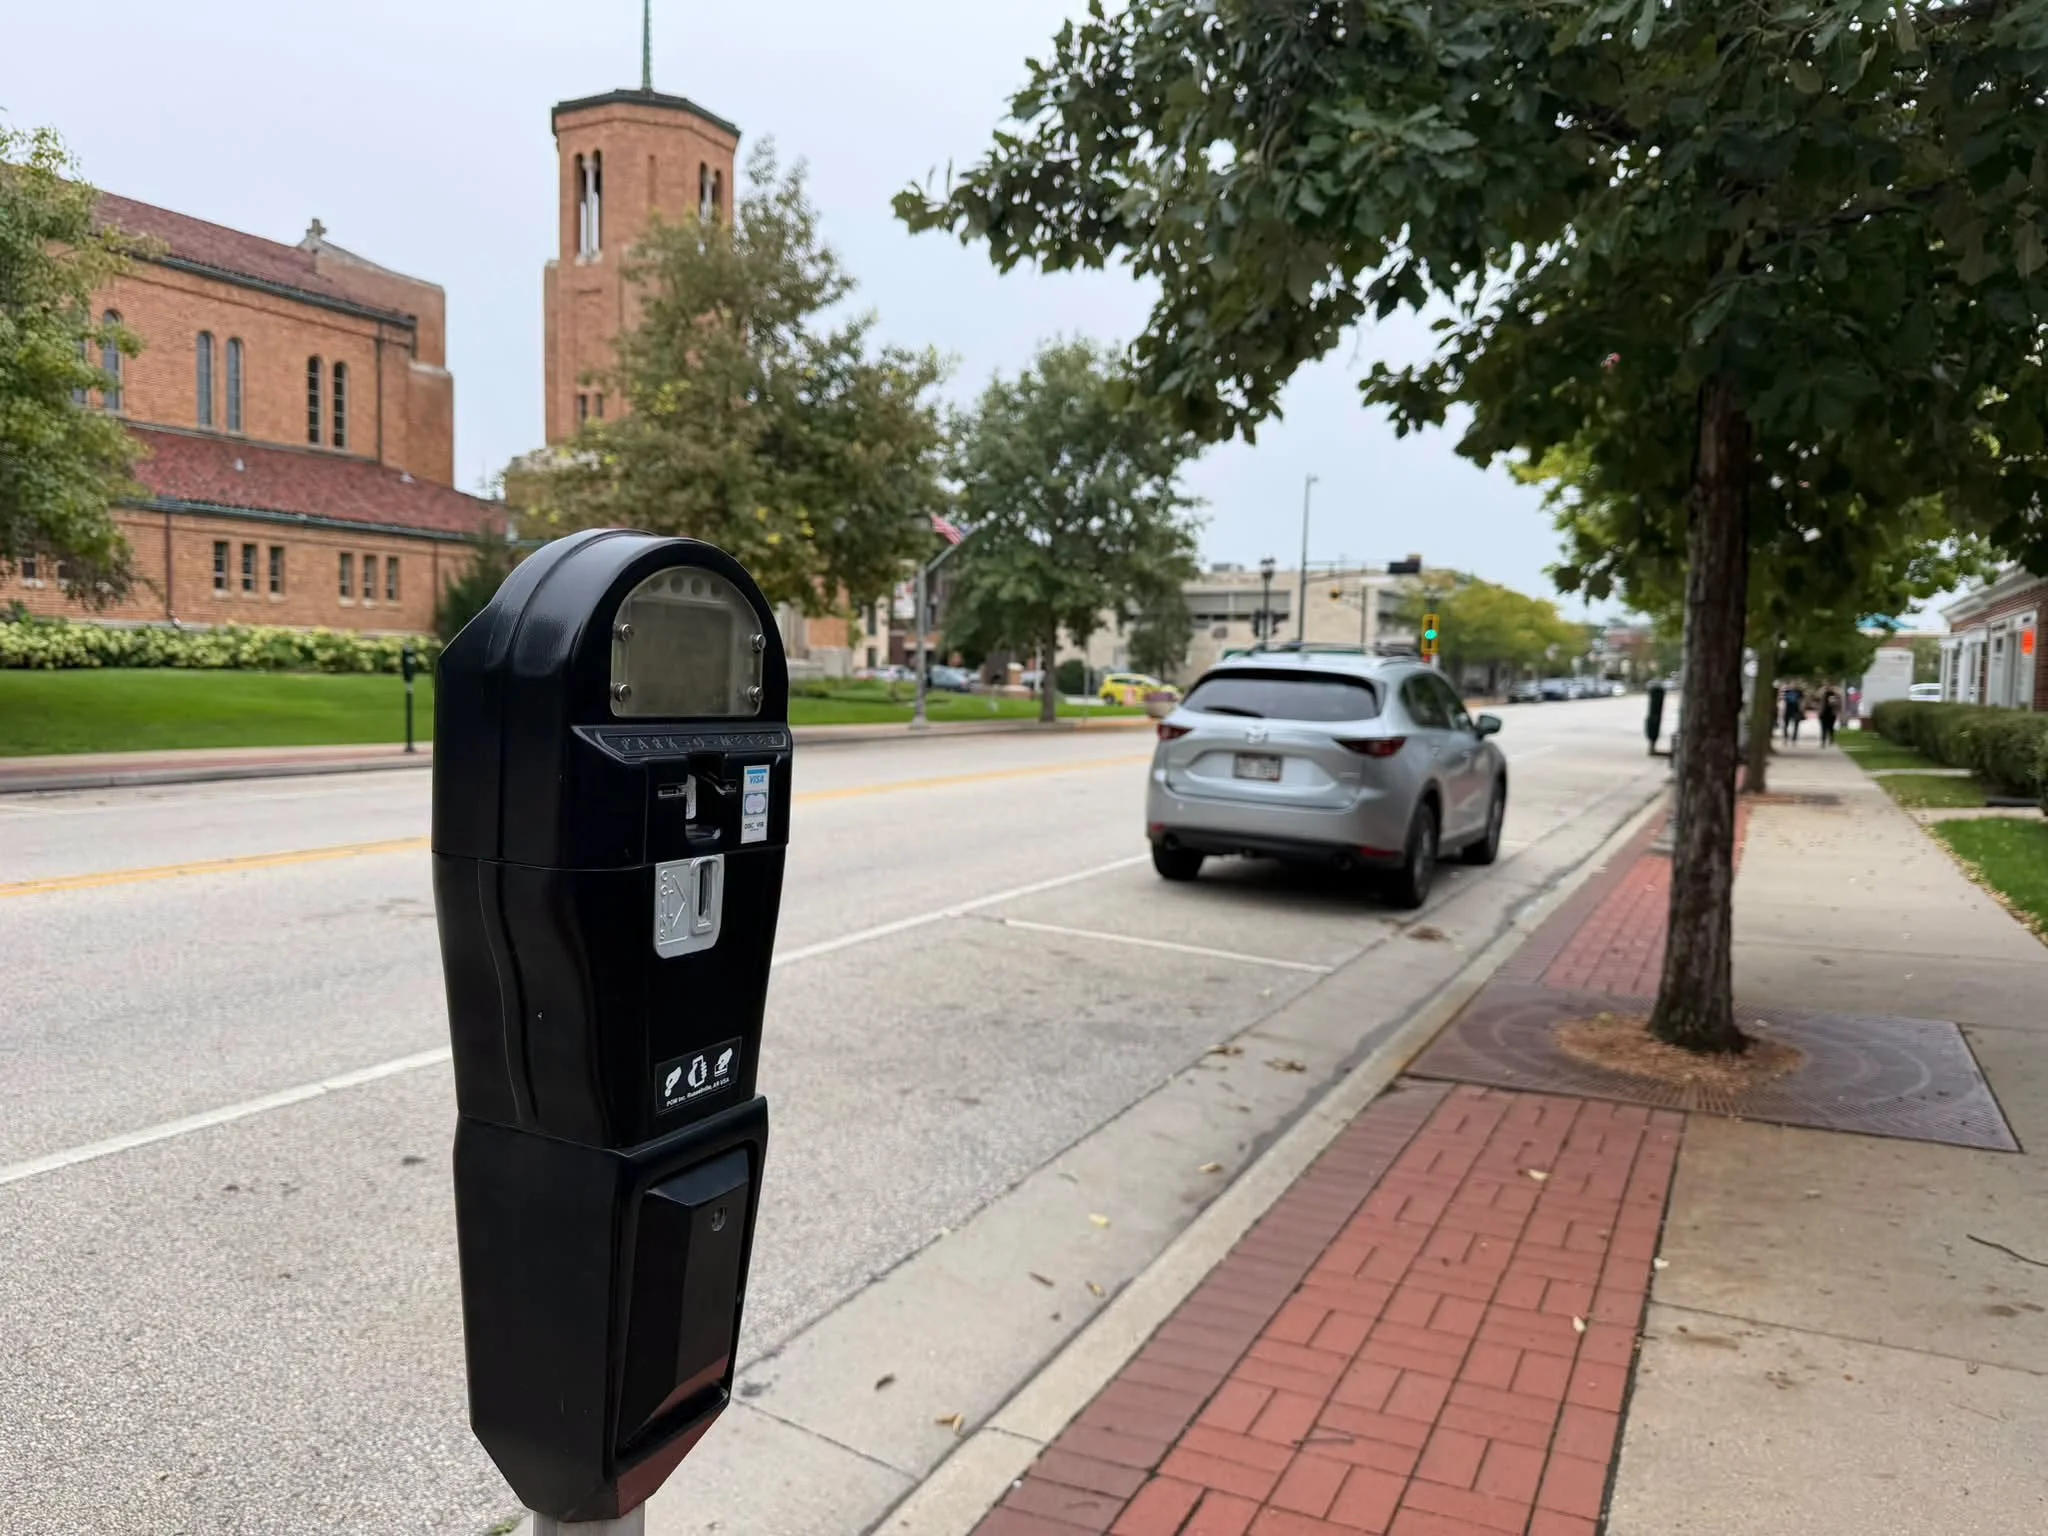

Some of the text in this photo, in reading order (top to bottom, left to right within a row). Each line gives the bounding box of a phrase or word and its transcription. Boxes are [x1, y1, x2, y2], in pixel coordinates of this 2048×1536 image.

[749, 775, 765, 785] VISA
[659, 870, 668, 941] COINS
[720, 1077, 730, 1085] USA
